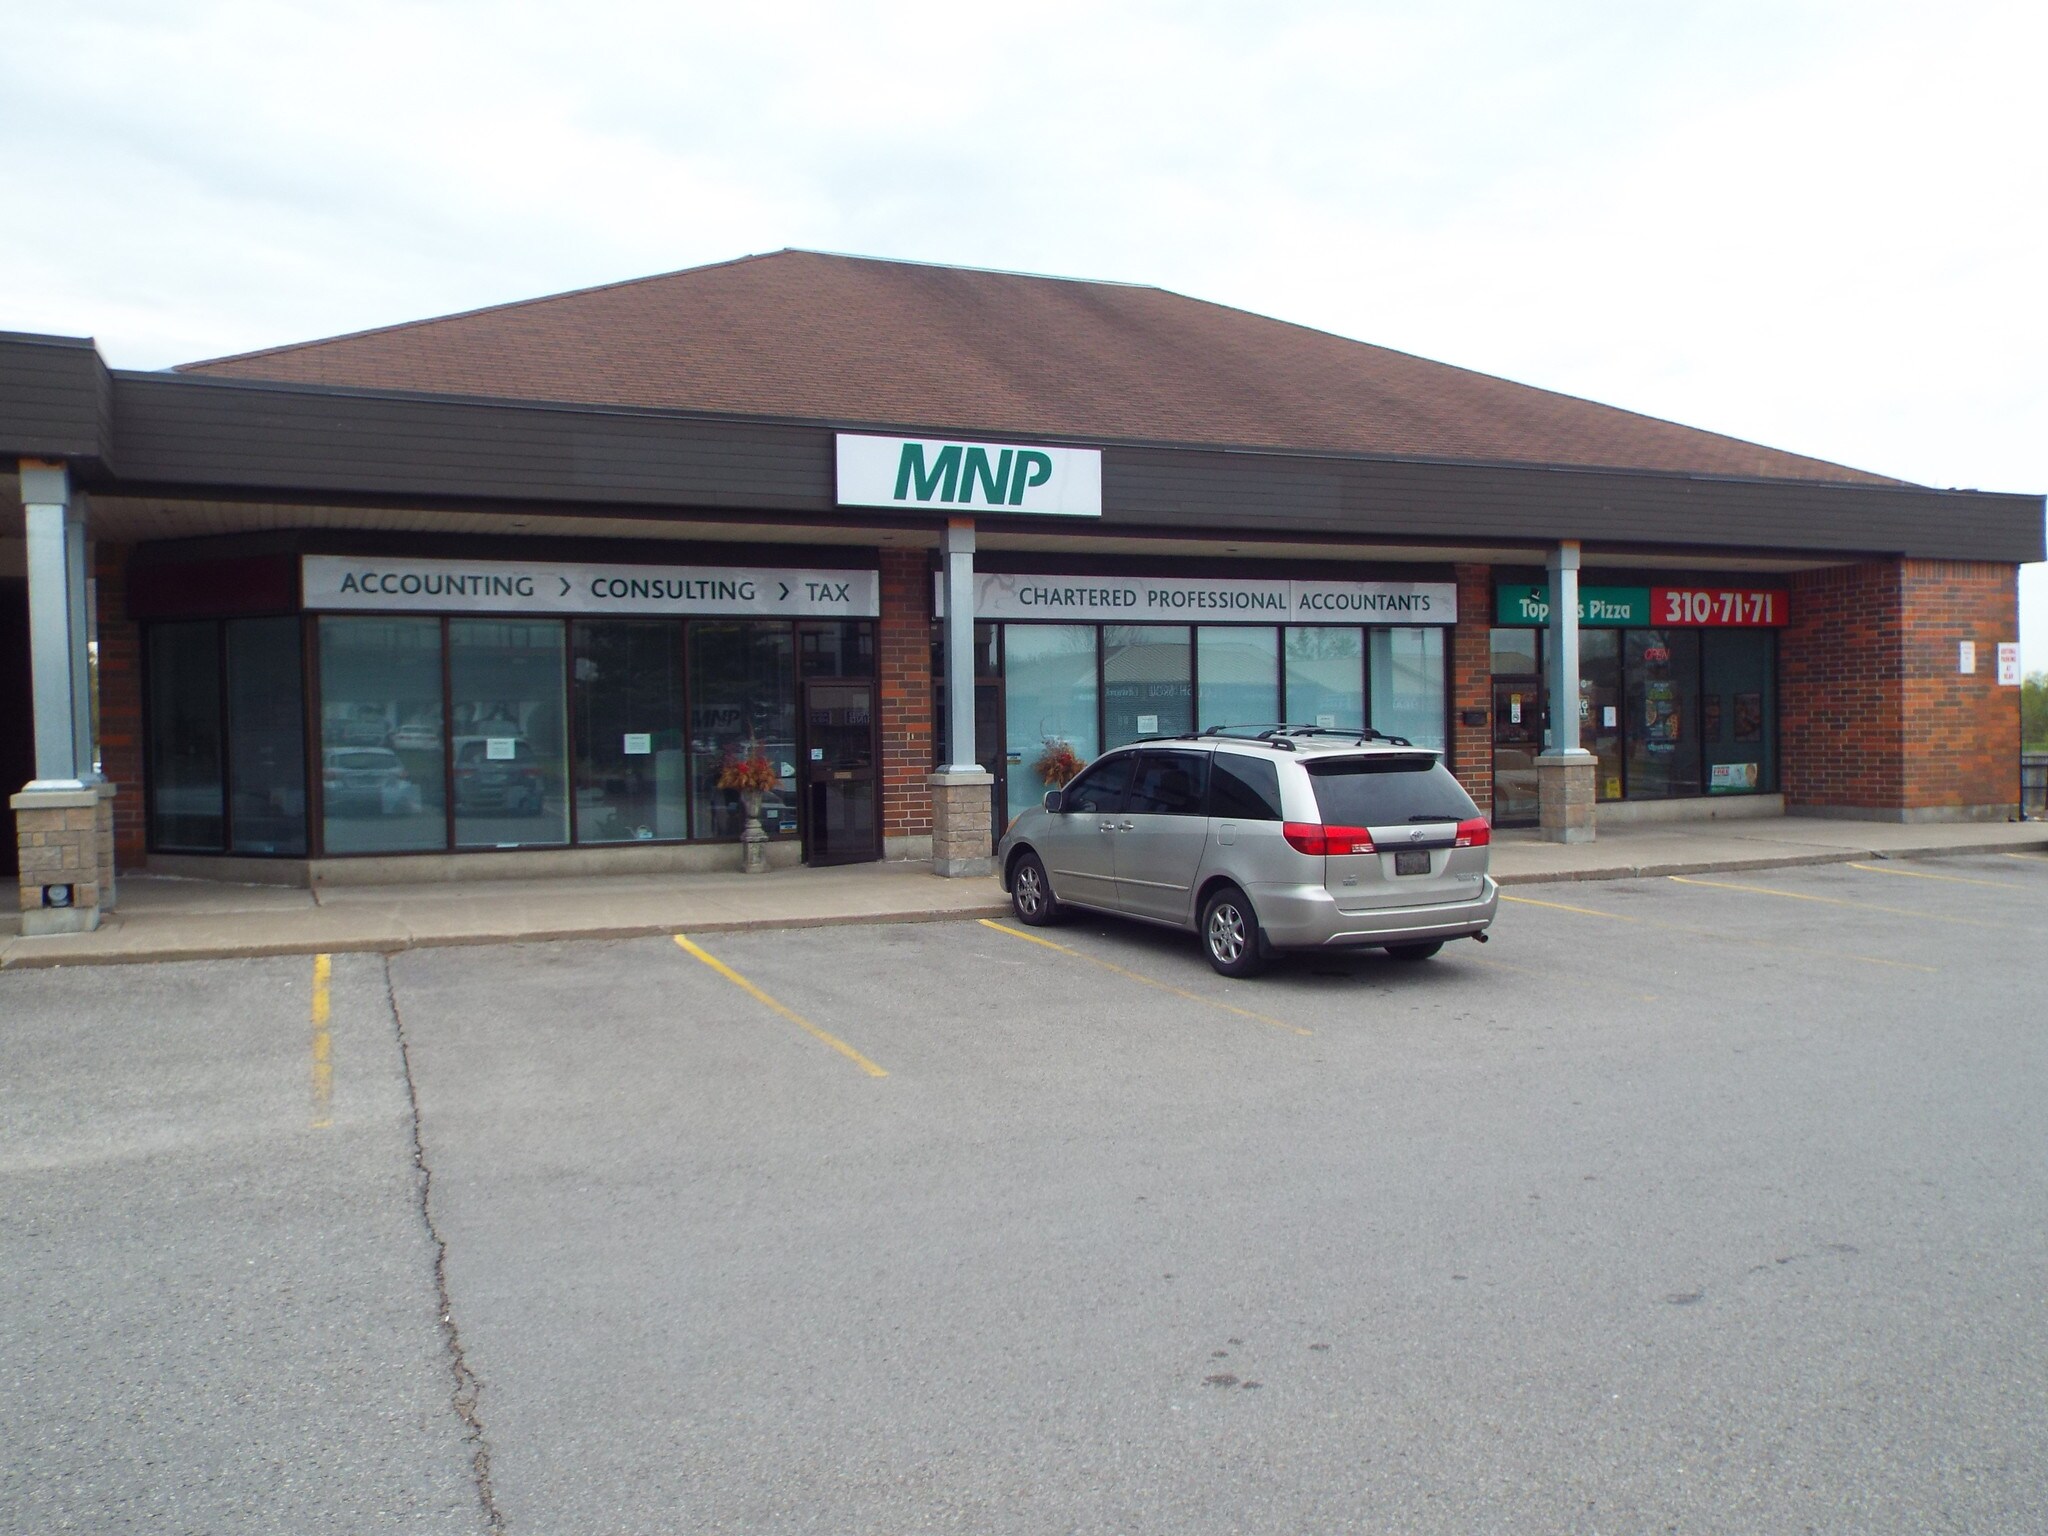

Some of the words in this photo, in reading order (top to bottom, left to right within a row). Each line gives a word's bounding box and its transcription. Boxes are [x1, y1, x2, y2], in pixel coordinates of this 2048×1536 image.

[894, 443, 1053, 506] MNP
[340, 572, 534, 598] ACCOUNTING
[590, 577, 756, 602] CONSULTING
[805, 582, 850, 603] TAX
[1019, 587, 1137, 607] CHARTERED
[1148, 590, 1287, 609] PROFESSIONAL
[1299, 593, 1431, 611] ACCOUNTANTS
[1590, 600, 1631, 619] Pizza
[1644, 648, 1670, 661] OPEN
